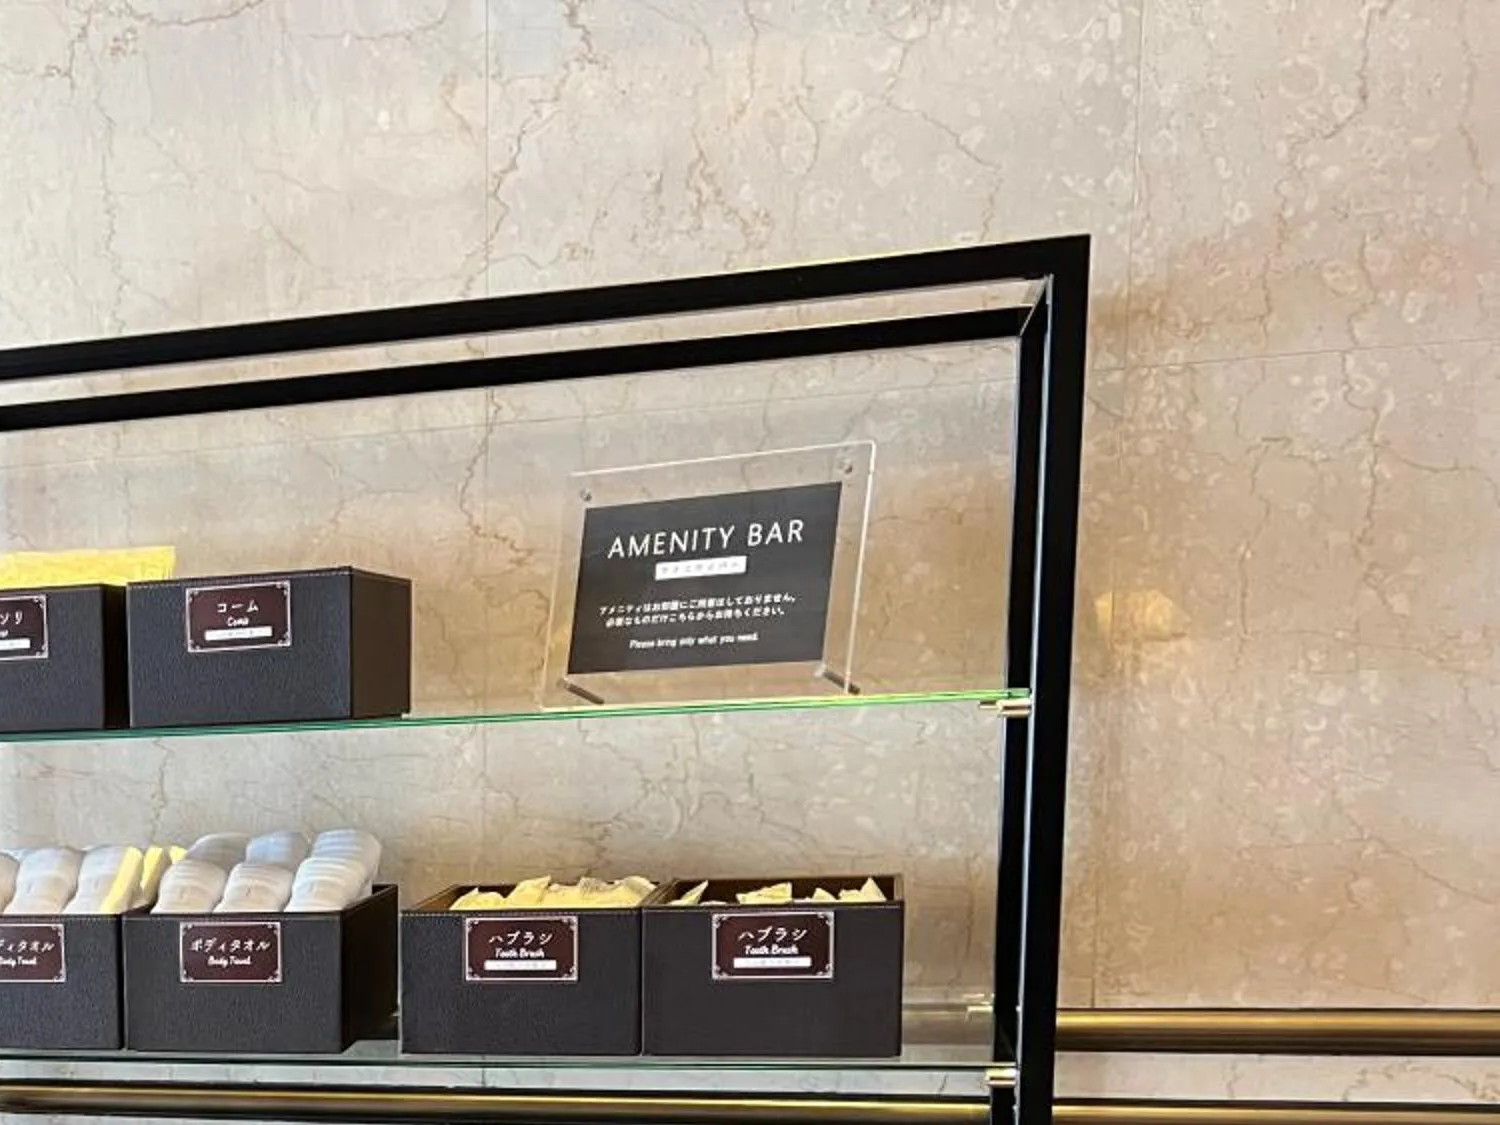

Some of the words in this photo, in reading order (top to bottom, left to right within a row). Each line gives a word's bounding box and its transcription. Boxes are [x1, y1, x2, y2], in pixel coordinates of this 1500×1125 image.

[607, 525, 735, 559] AMENITY
[747, 518, 804, 547] BAR
[216, 599, 259, 613] コーム
[488, 930, 554, 946] ハブラシ
[738, 925, 807, 943] ハブラシ
[190, 937, 271, 953] ボディタオル
[745, 945, 769, 956] Tooth
[770, 944, 799, 955] Brush
[495, 947, 518, 958] Tooth
[519, 947, 545, 958] Brush
[17, 955, 37, 965] Towel
[207, 955, 229, 968] Body
[230, 955, 252, 966] Towel
